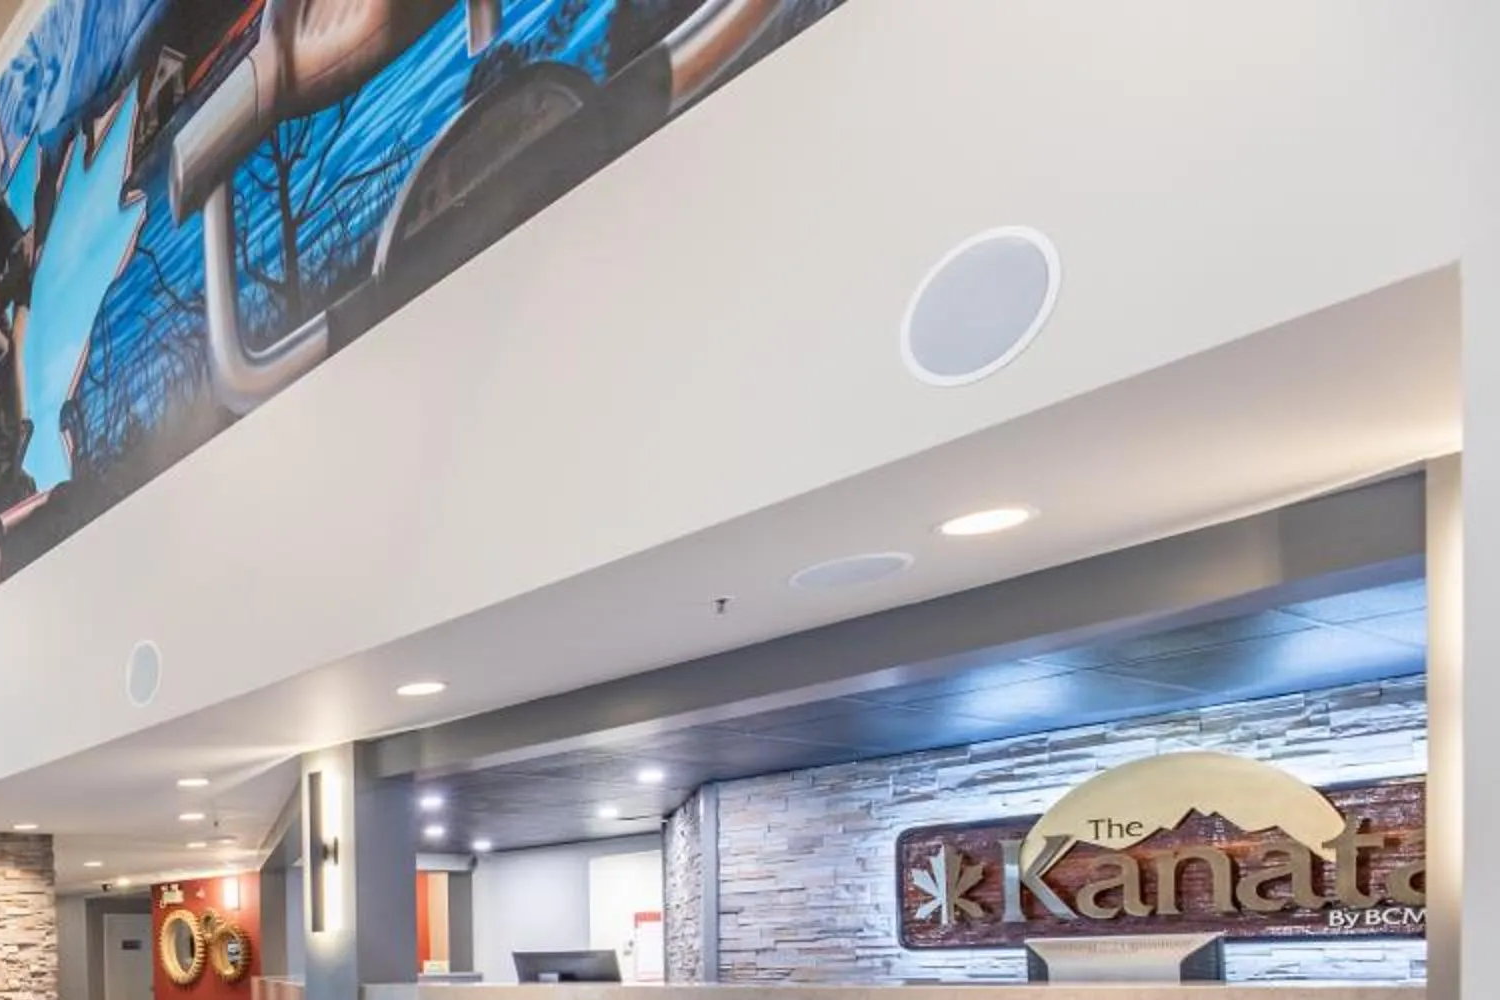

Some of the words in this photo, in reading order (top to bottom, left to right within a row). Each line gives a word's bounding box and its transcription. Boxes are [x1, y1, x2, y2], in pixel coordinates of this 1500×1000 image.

[1086, 817, 1144, 840] The
[1329, 908, 1360, 929] By
[1365, 906, 1428, 926] BCM
